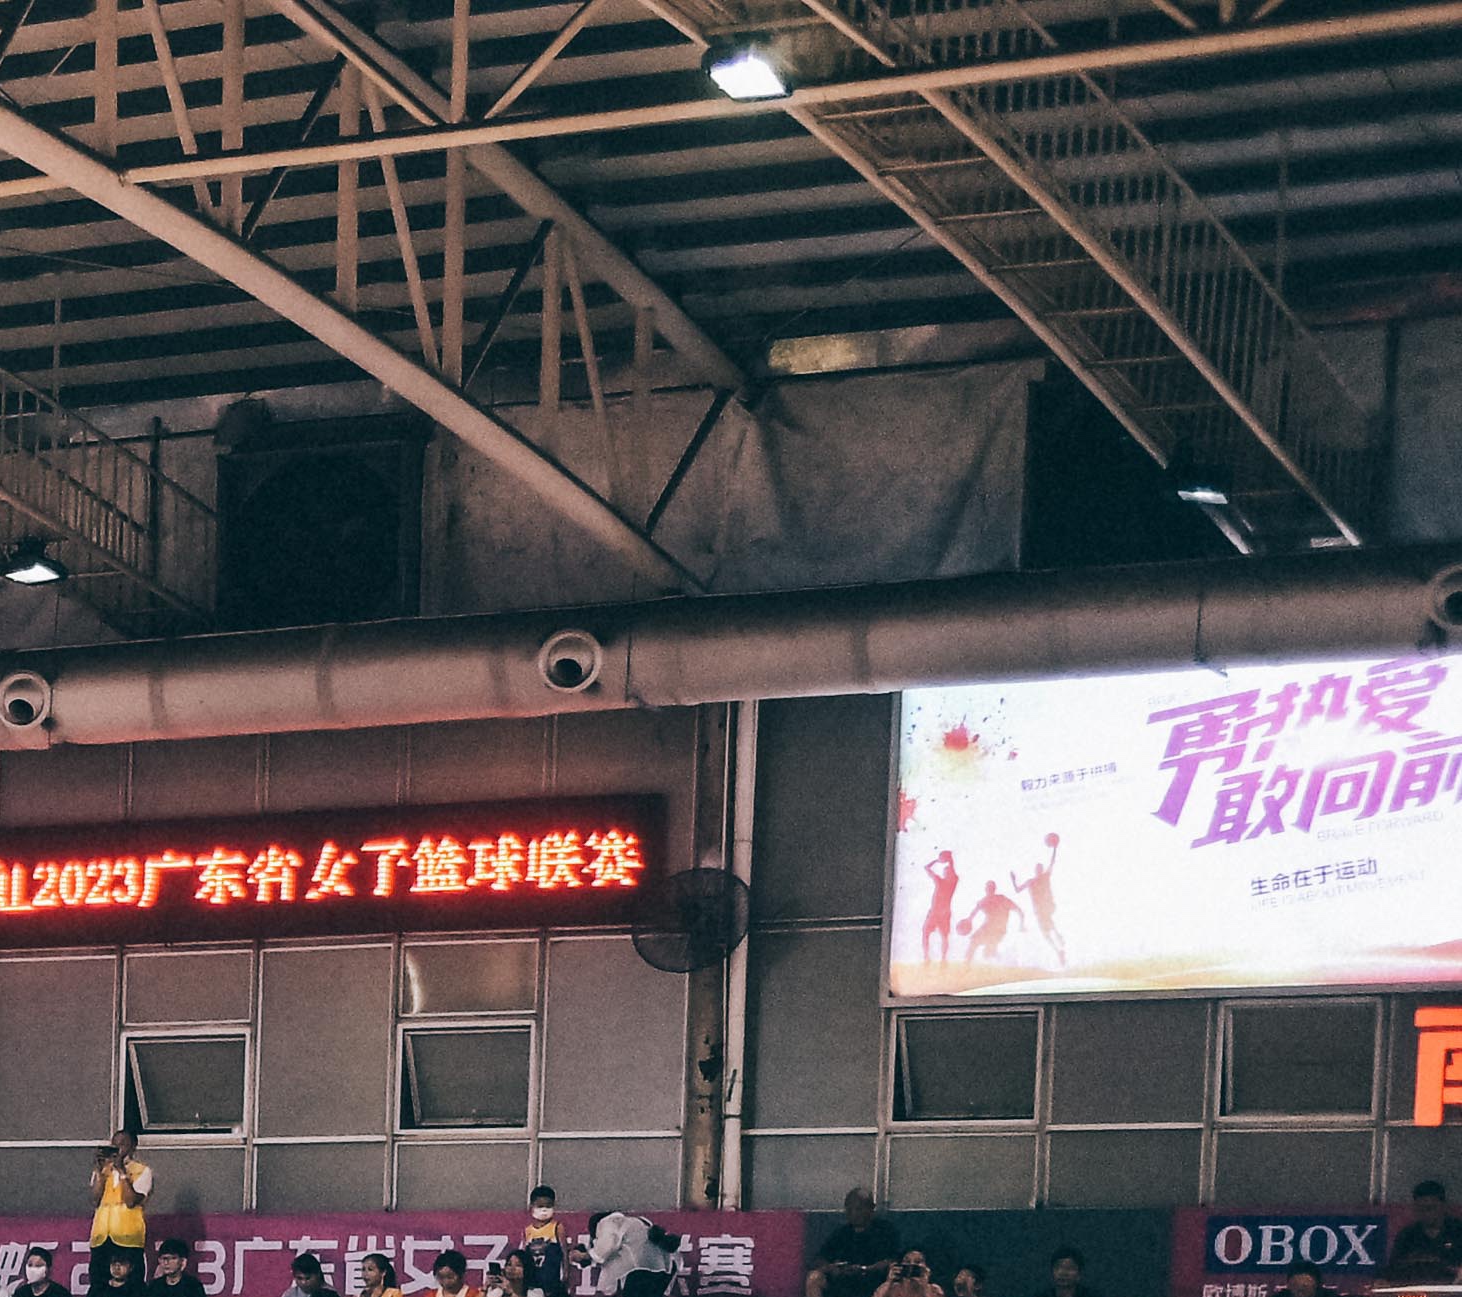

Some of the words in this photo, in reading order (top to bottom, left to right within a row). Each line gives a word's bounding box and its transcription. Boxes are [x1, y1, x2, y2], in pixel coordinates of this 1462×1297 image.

[1250, 857, 1378, 897] 生命在于运动
[1214, 1224, 1378, 1266] OBOX
